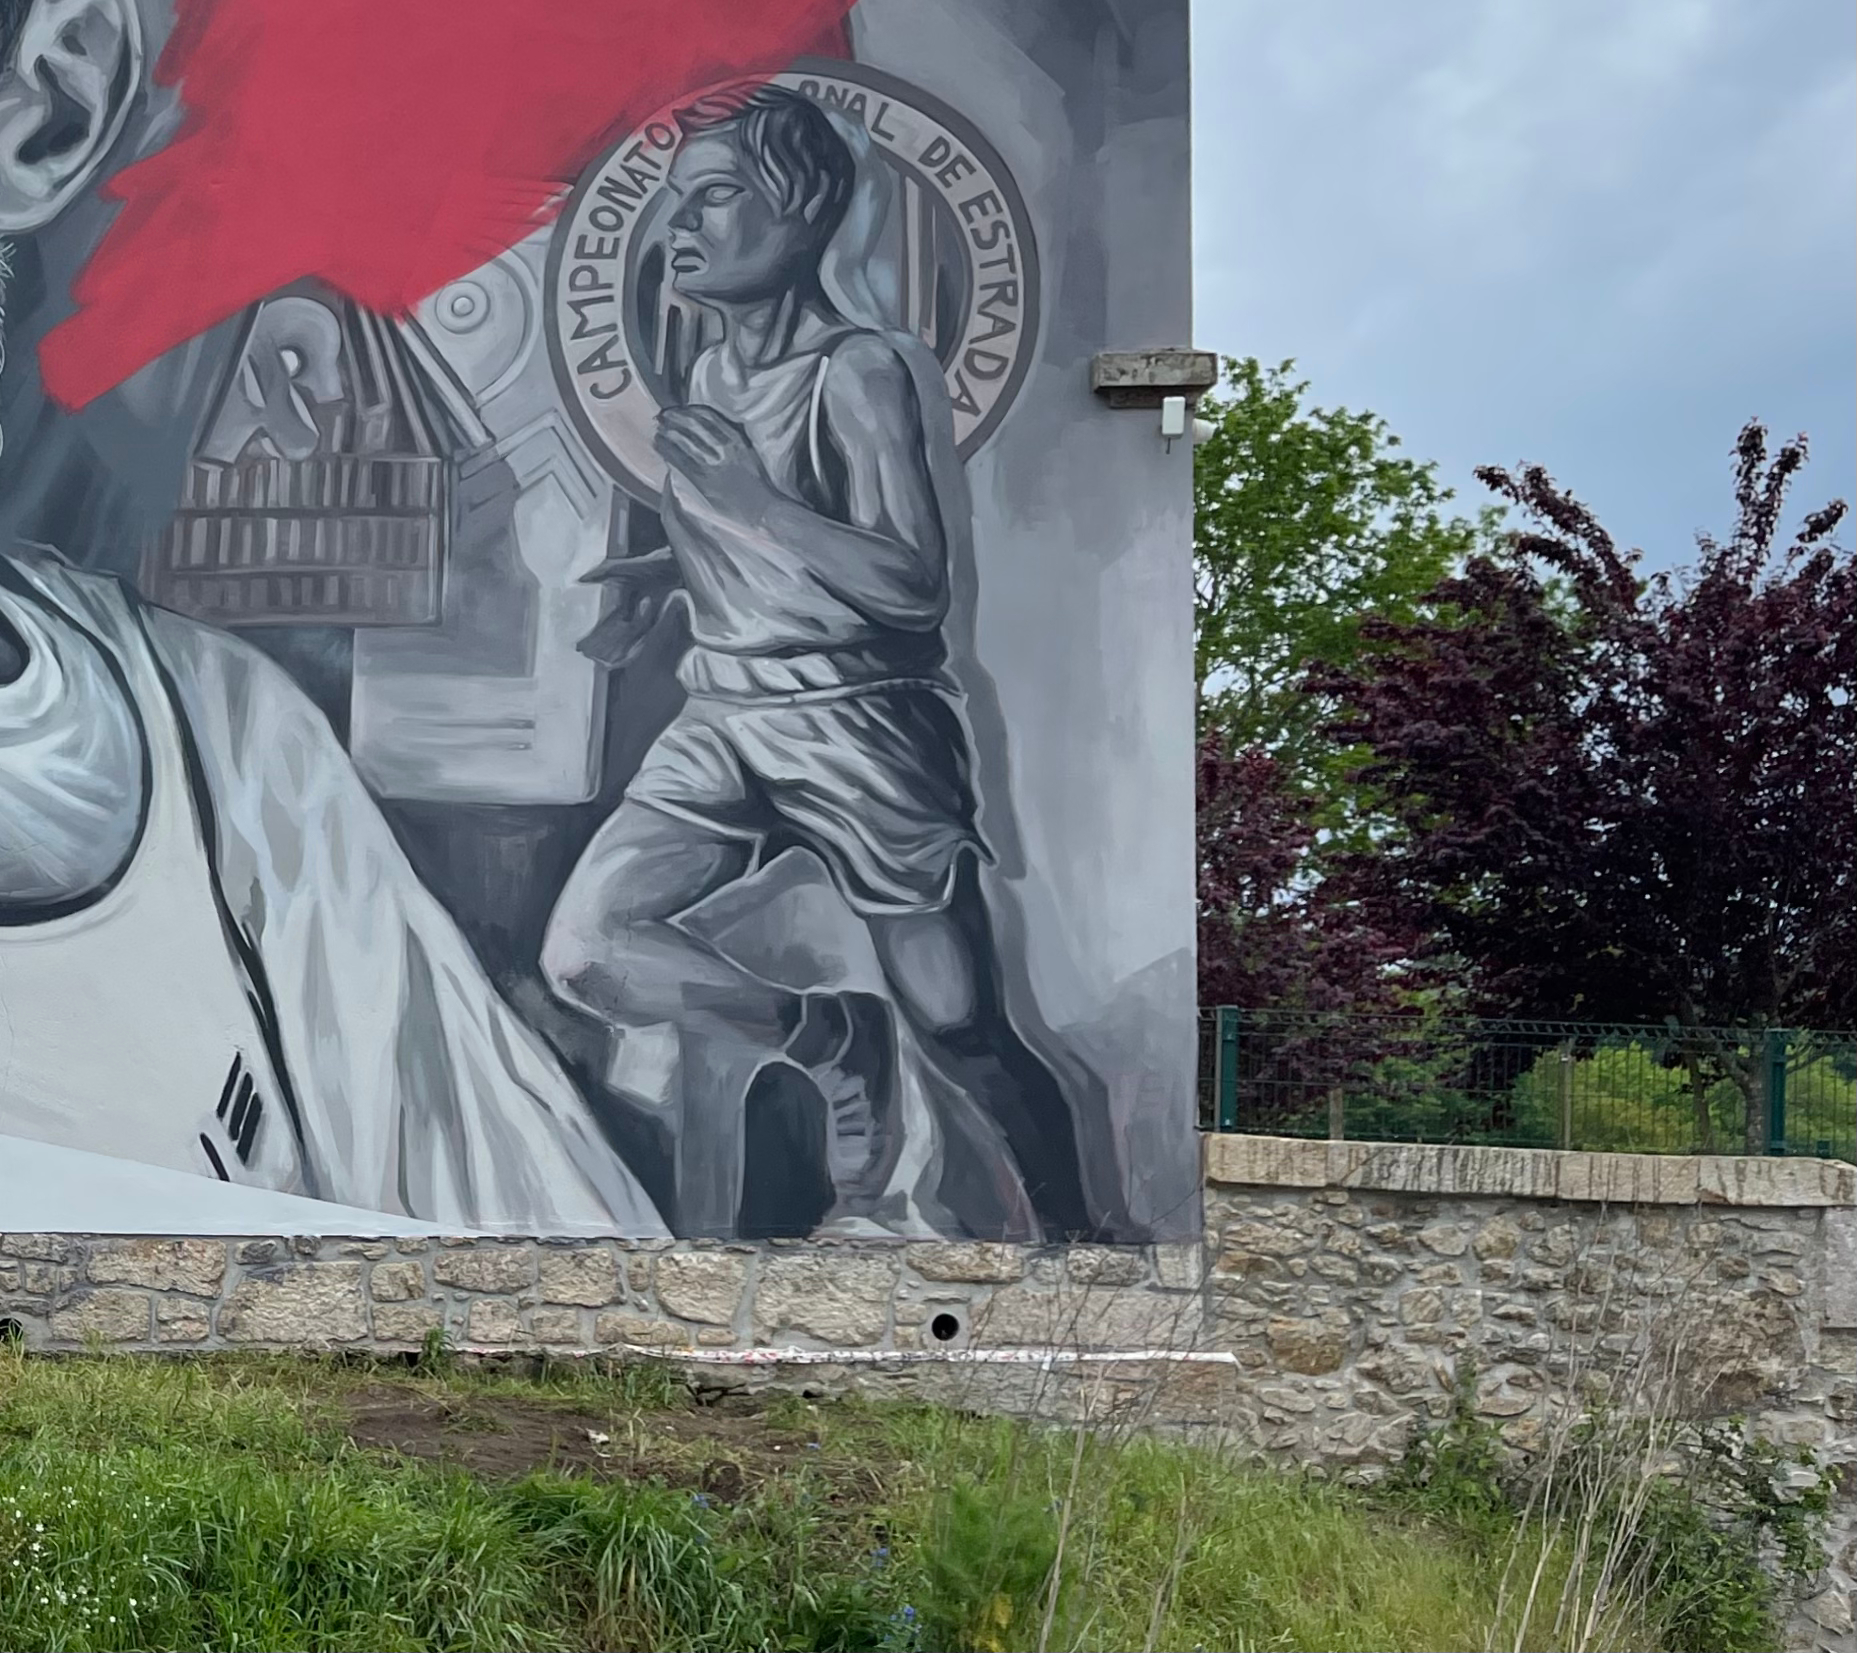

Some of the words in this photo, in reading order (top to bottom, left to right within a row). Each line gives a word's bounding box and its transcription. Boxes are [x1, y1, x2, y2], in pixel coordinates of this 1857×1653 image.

[567, 122, 676, 400] CAMPEONATO
[917, 135, 977, 189] DE
[952, 189, 1019, 418] ESTRADA
